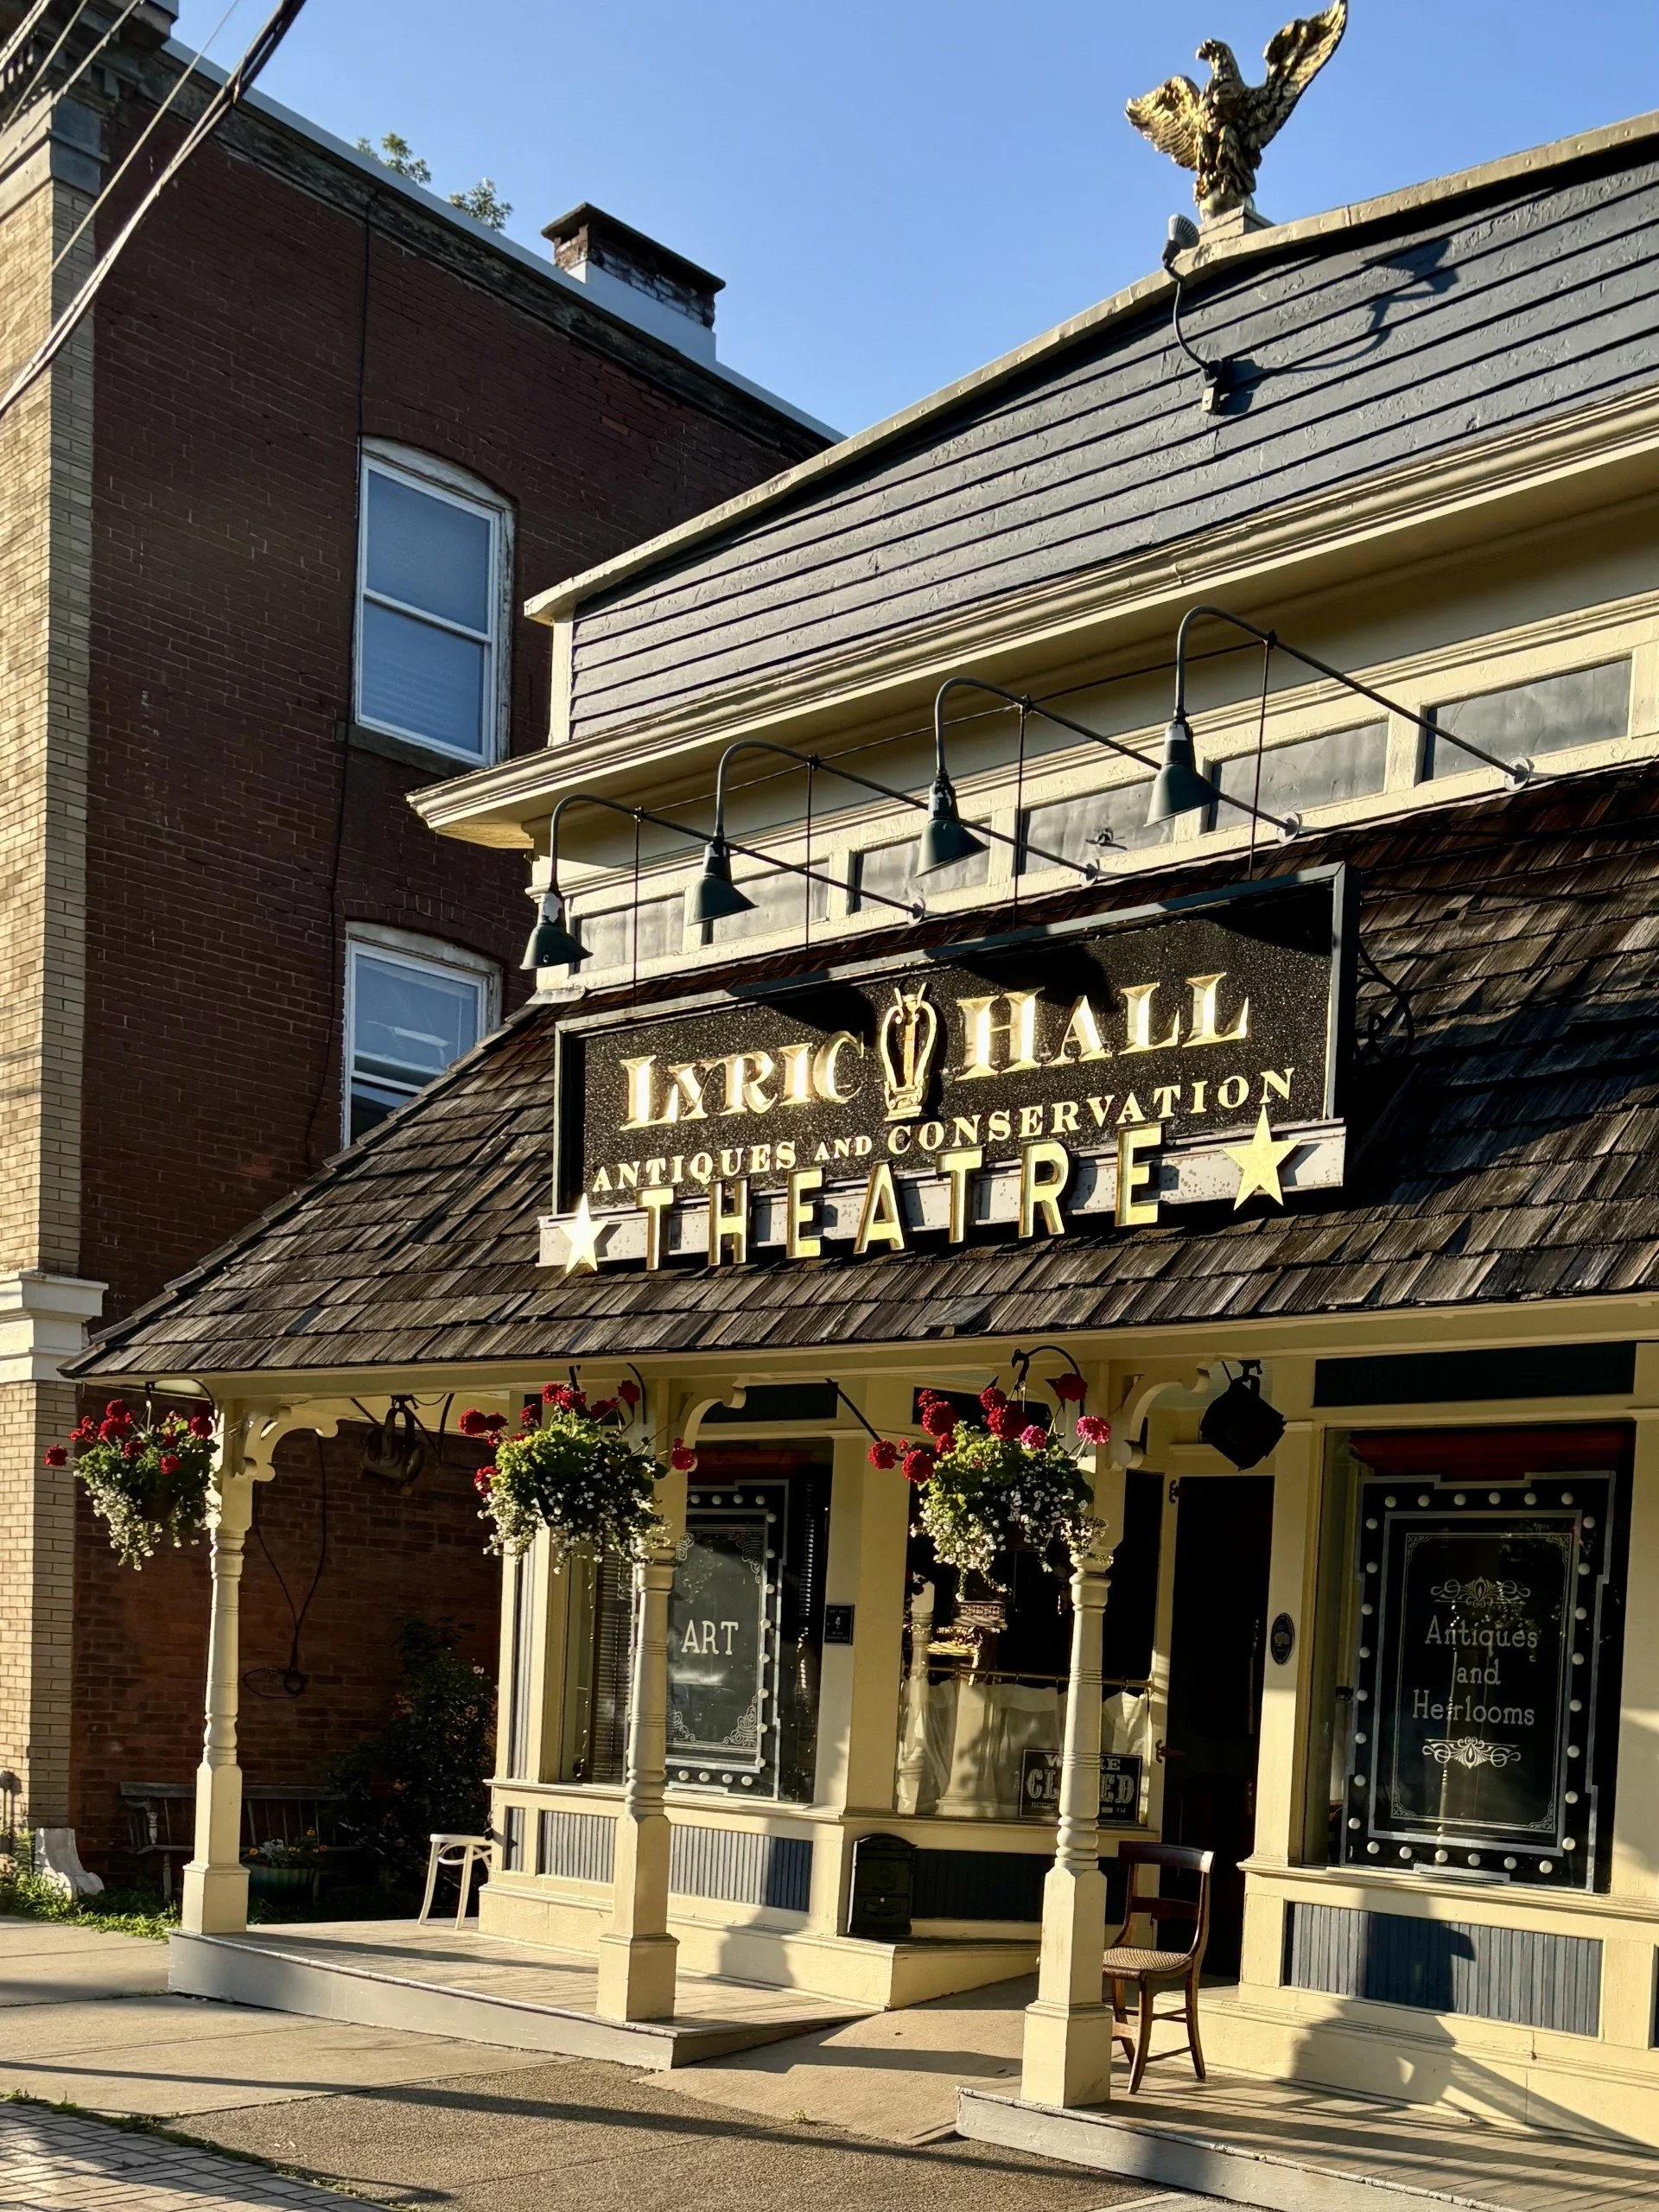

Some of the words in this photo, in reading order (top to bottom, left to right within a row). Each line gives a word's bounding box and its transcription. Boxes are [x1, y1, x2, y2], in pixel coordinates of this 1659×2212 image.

[620, 1030, 864, 1130] LYRIC
[955, 972, 1249, 1081] HALL
[592, 1140, 798, 1193] ANTIQUES
[814, 1135, 873, 1161] AND
[887, 1068, 1295, 1155] CONSERVATION
[636, 1122, 1166, 1271] THEATRE
[680, 1618, 739, 1656] ART
[1424, 1614, 1539, 1657] Antiques
[1456, 1658, 1501, 1685] and
[1412, 1688, 1535, 1726] Heirlooms
[1026, 1768, 1135, 1804] CLED
